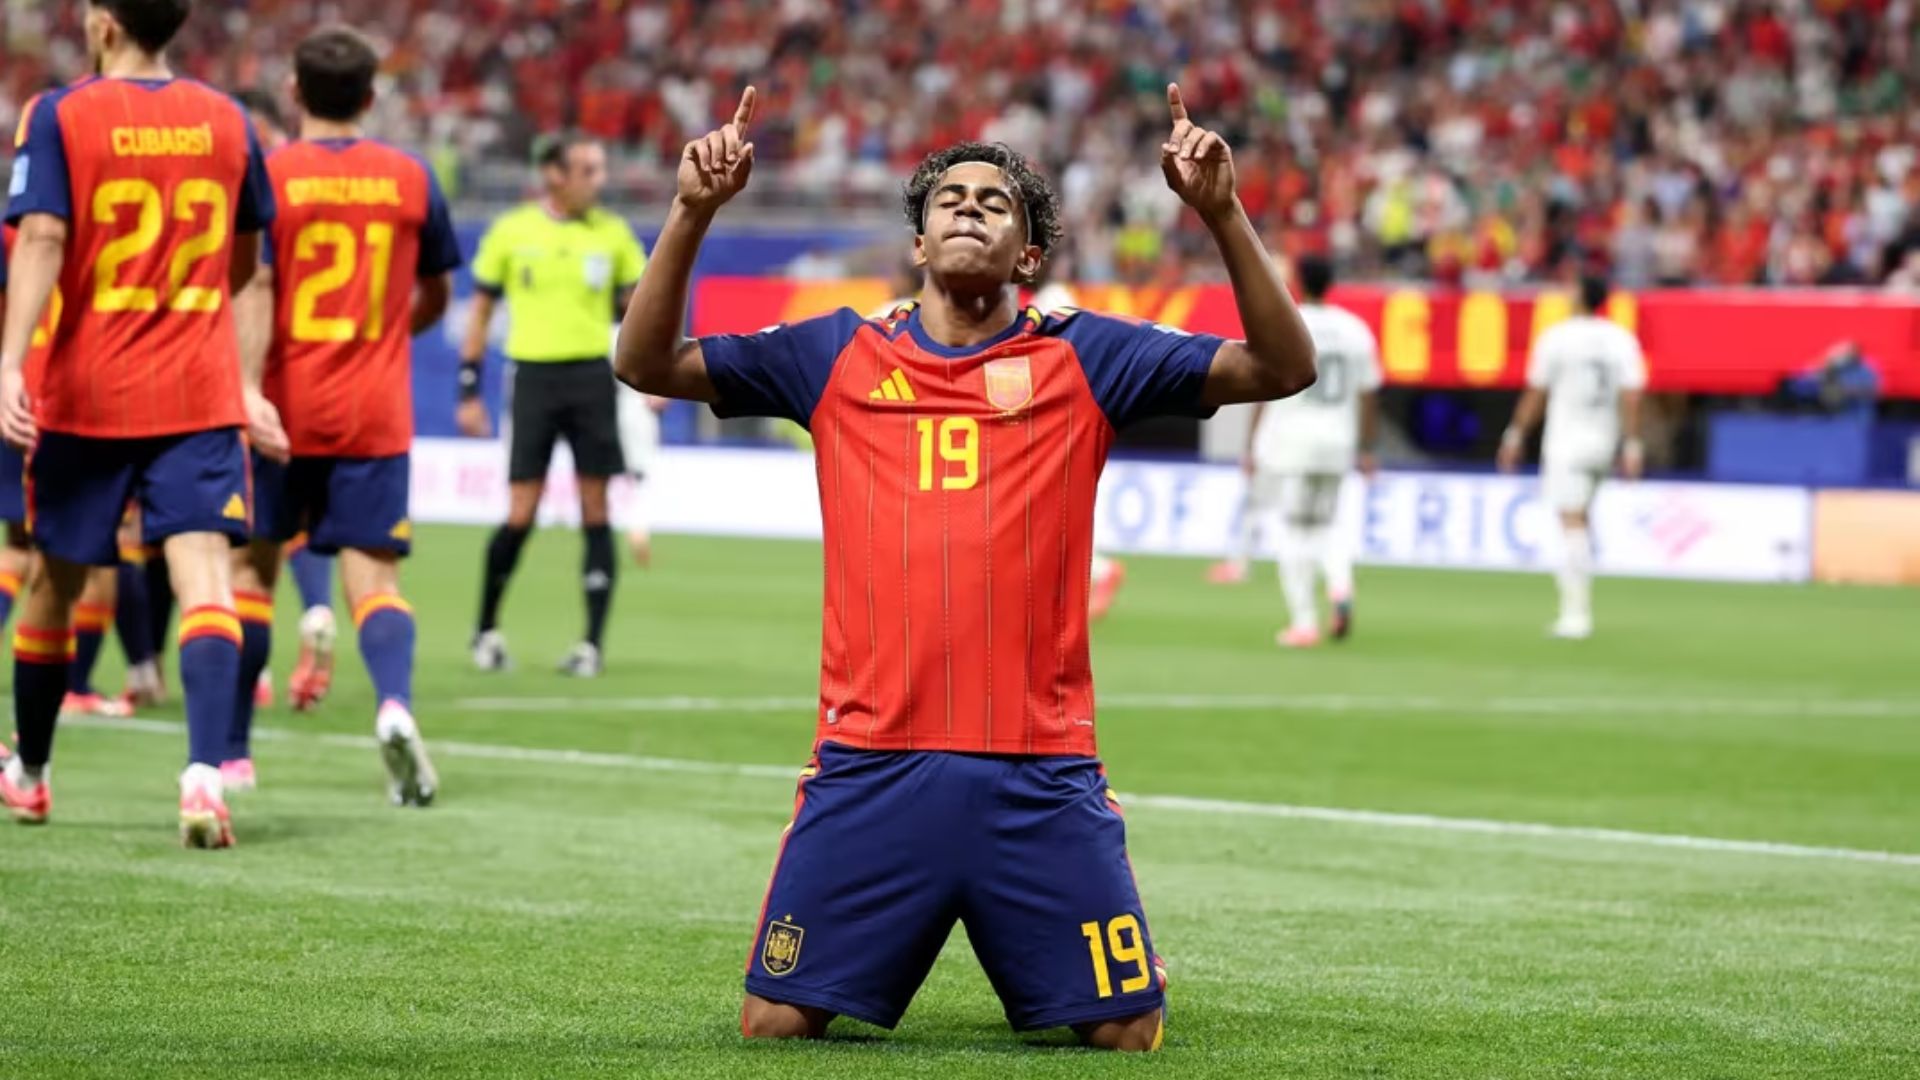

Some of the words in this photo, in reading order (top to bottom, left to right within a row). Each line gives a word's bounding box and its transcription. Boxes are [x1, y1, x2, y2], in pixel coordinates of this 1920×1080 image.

[111, 121, 212, 156] CUBARSÍ
[92, 178, 228, 312] 22
[291, 221, 394, 341] 21
[917, 416, 979, 491] 19
[1108, 472, 1198, 546] OF
[1230, 477, 1545, 560] ERIC
[1081, 913, 1150, 998] 19
